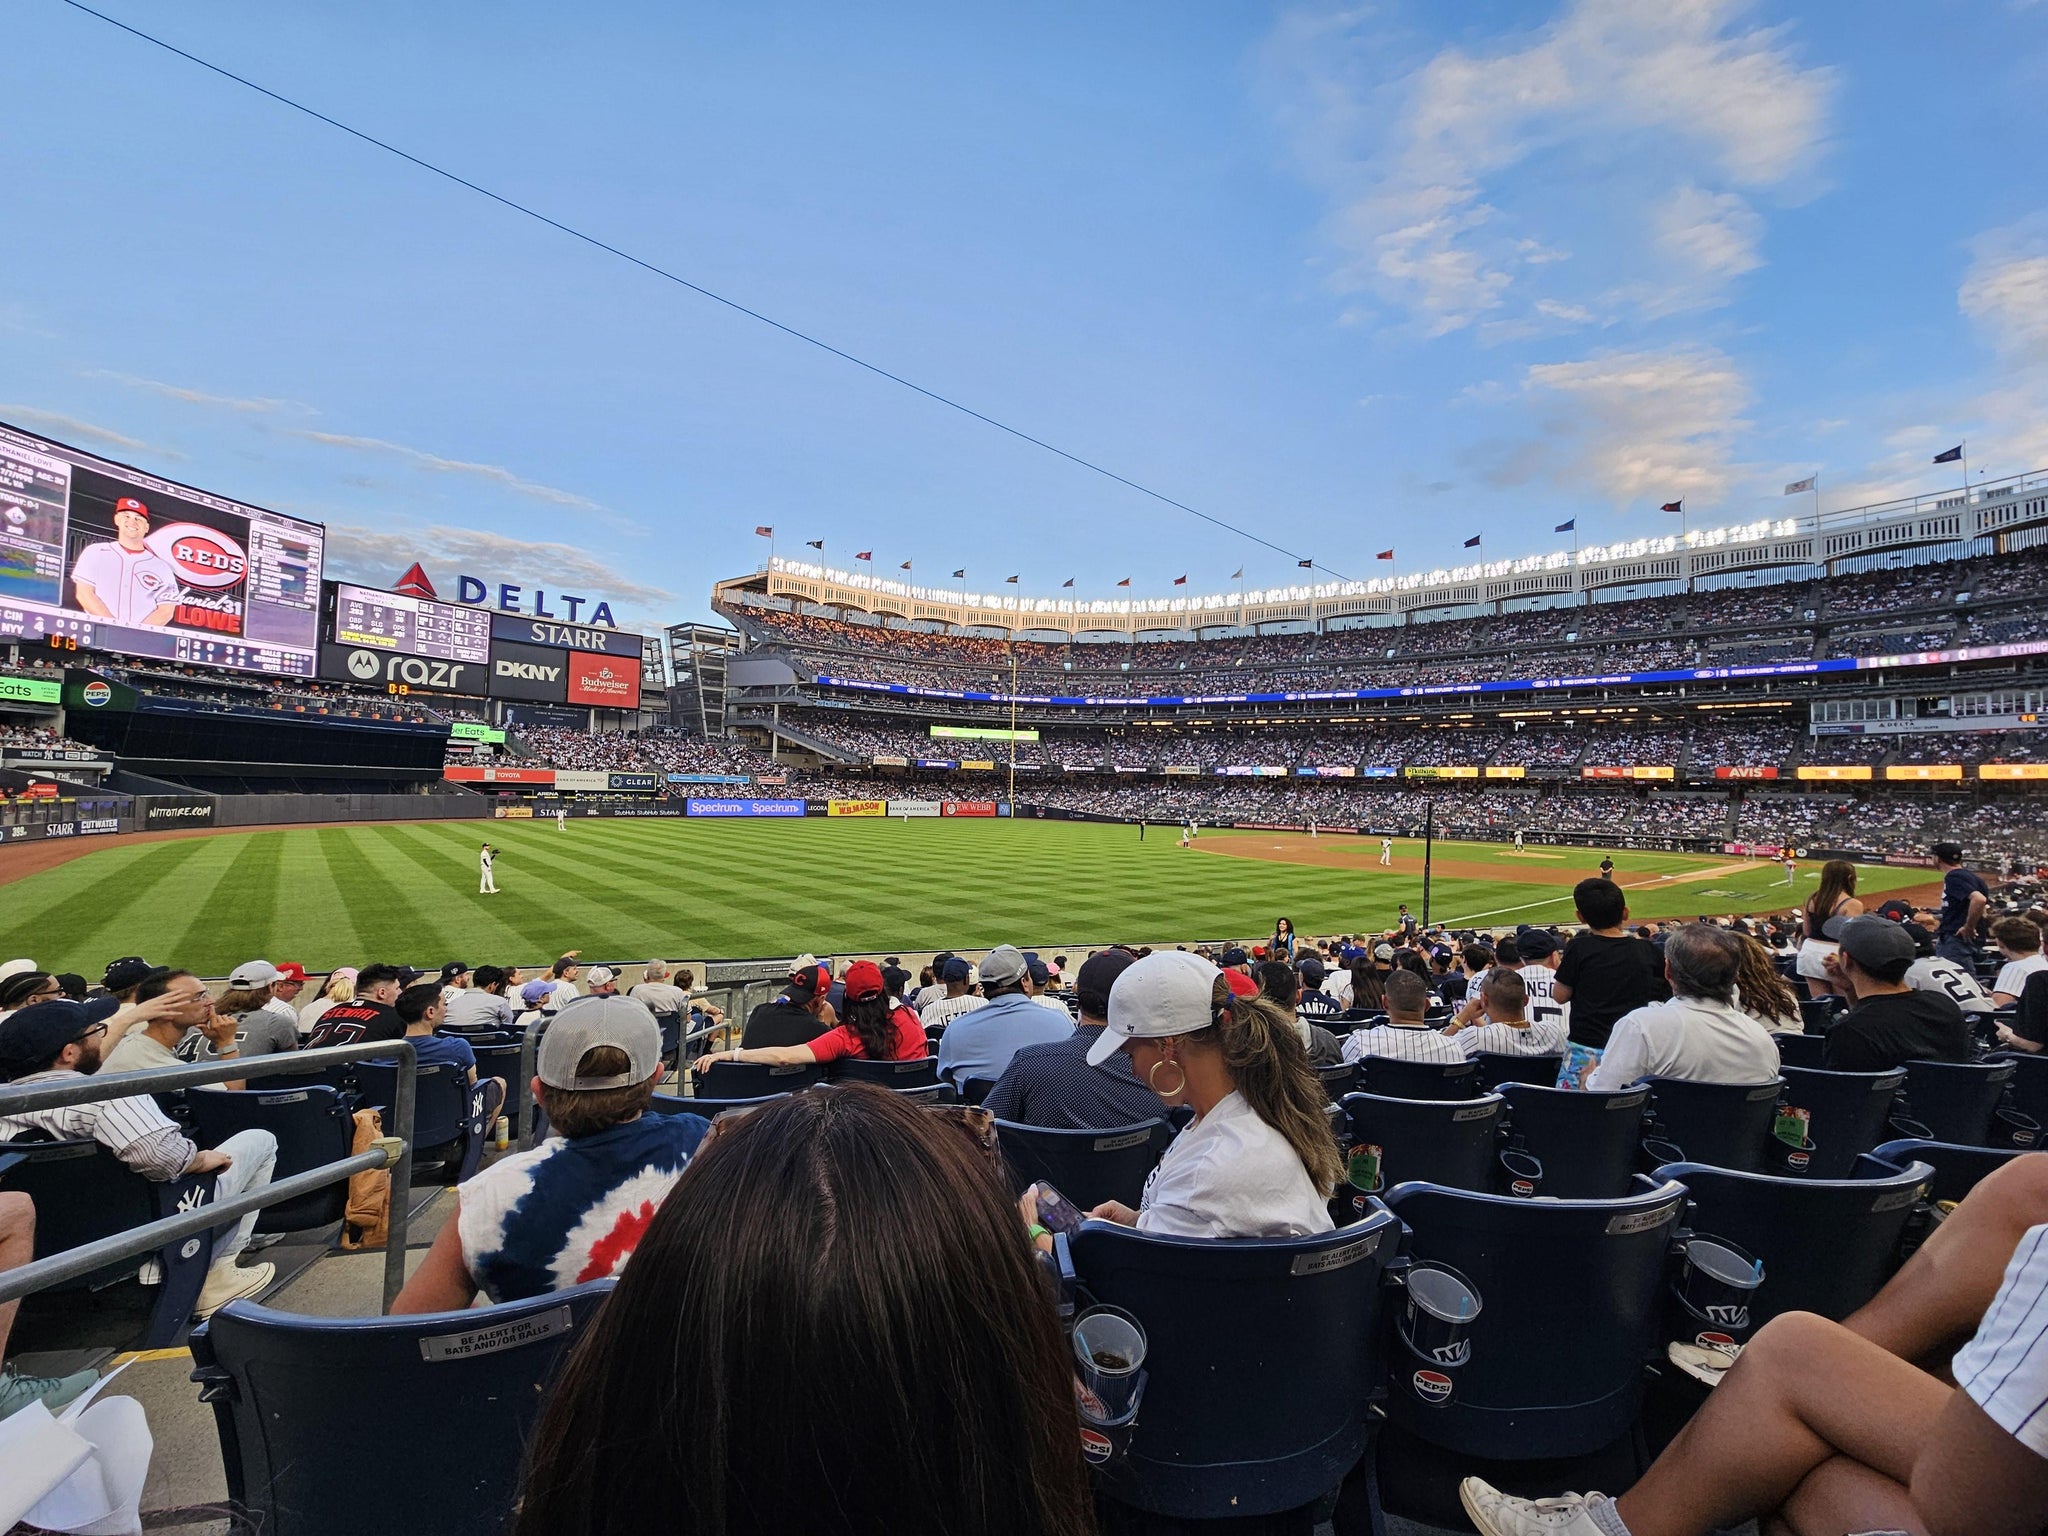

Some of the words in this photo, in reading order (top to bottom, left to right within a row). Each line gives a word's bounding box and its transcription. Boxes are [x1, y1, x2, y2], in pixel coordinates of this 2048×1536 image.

[176, 543, 244, 573] REDS
[150, 582, 228, 610] Nathaniel
[222, 600, 241, 615] 31
[350, 601, 363, 609] AVG
[458, 575, 617, 628] DELTA
[4, 610, 23, 622] CIN
[56, 619, 64, 628] 0
[70, 622, 78, 630] 0
[84, 624, 91, 632] 0
[174, 606, 241, 633] LOWE
[370, 620, 383, 628] SLG
[2, 623, 24, 634] NYY
[531, 622, 606, 651] STARR
[193, 641, 201, 649] 2
[238, 648, 246, 656] 2
[2001, 642, 2047, 656] BATTING
[237, 658, 245, 666] 2
[1919, 653, 1927, 664] S
[387, 656, 464, 688] razr
[496, 660, 561, 682] DKNY
[581, 676, 629, 689] Budweiser
[389, 683, 408, 696] 0:13
[465, 727, 485, 736] Eats
[1730, 768, 1763, 777] AVIS
[149, 806, 211, 818] NITTOTIRE.COM
[692, 803, 739, 814] Spectrum
[752, 803, 796, 814] Spectrum
[47, 823, 74, 836] STARR
[81, 819, 118, 829] CUTWATER
[12, 827, 24, 837] 399
[1885, 856, 1924, 864] Budweiser
[795, 974, 807, 985] C
[321, 1007, 381, 1021] STEWART
[472, 1092, 484, 1118] NY
[1330, 1248, 1350, 1259] ALERT
[1307, 1261, 1325, 1270] BATS
[1326, 1254, 1352, 1266] AND/OR
[445, 1344, 471, 1356] BATS
[474, 1335, 516, 1351] AND/OR
[518, 1324, 550, 1341] BALLS
[461, 1336, 477, 1346] BE
[477, 1328, 508, 1343] ALERT
[512, 1322, 531, 1334] FOR
[1416, 1376, 1450, 1392] PEPSI
